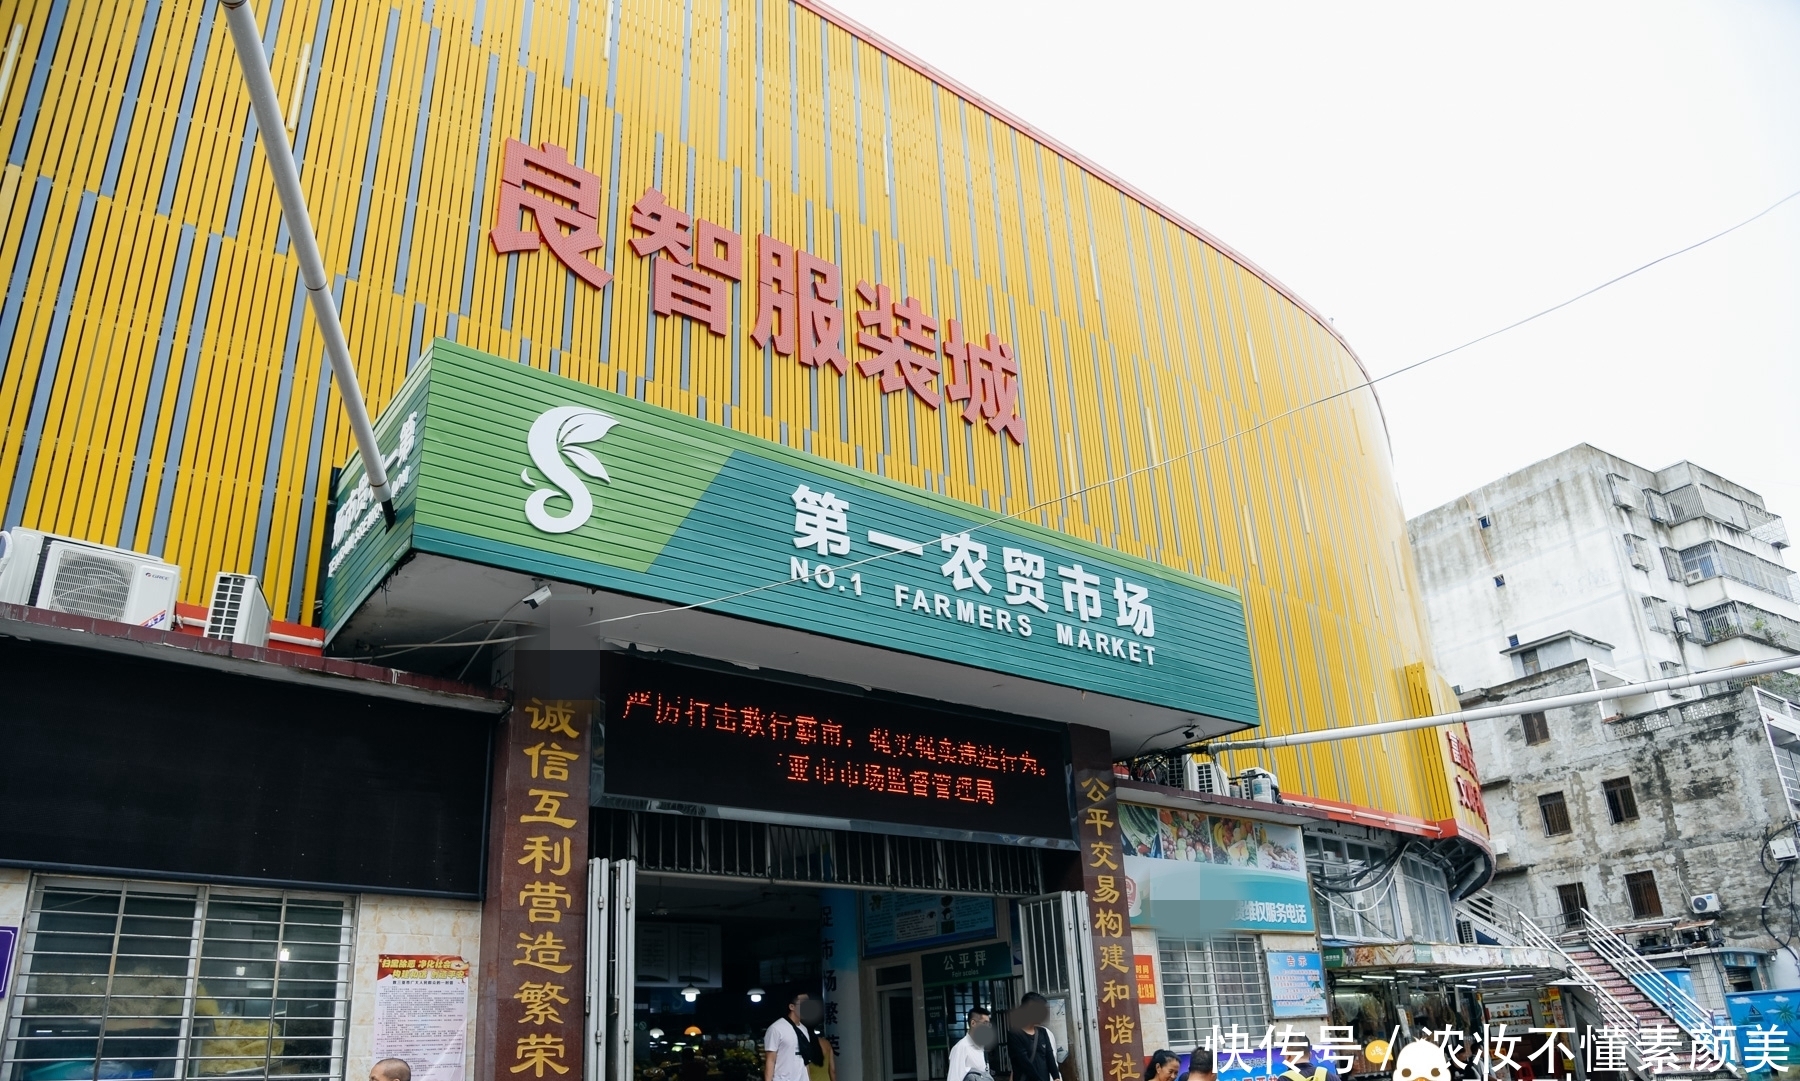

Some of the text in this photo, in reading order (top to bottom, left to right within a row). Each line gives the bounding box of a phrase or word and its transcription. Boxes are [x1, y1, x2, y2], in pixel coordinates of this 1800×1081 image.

[489, 137, 1026, 445] 良智服装城
[790, 556, 1156, 666] NO.1 FARMERS MARKET
[791, 483, 1155, 638] 第一农贸市场
[509, 698, 580, 1078] 诚信互利营造繁荣
[943, 950, 987, 971] 公平秤
[1080, 777, 1141, 1081] 公平交易构建和谐社
[1287, 955, 1307, 967] 告示
